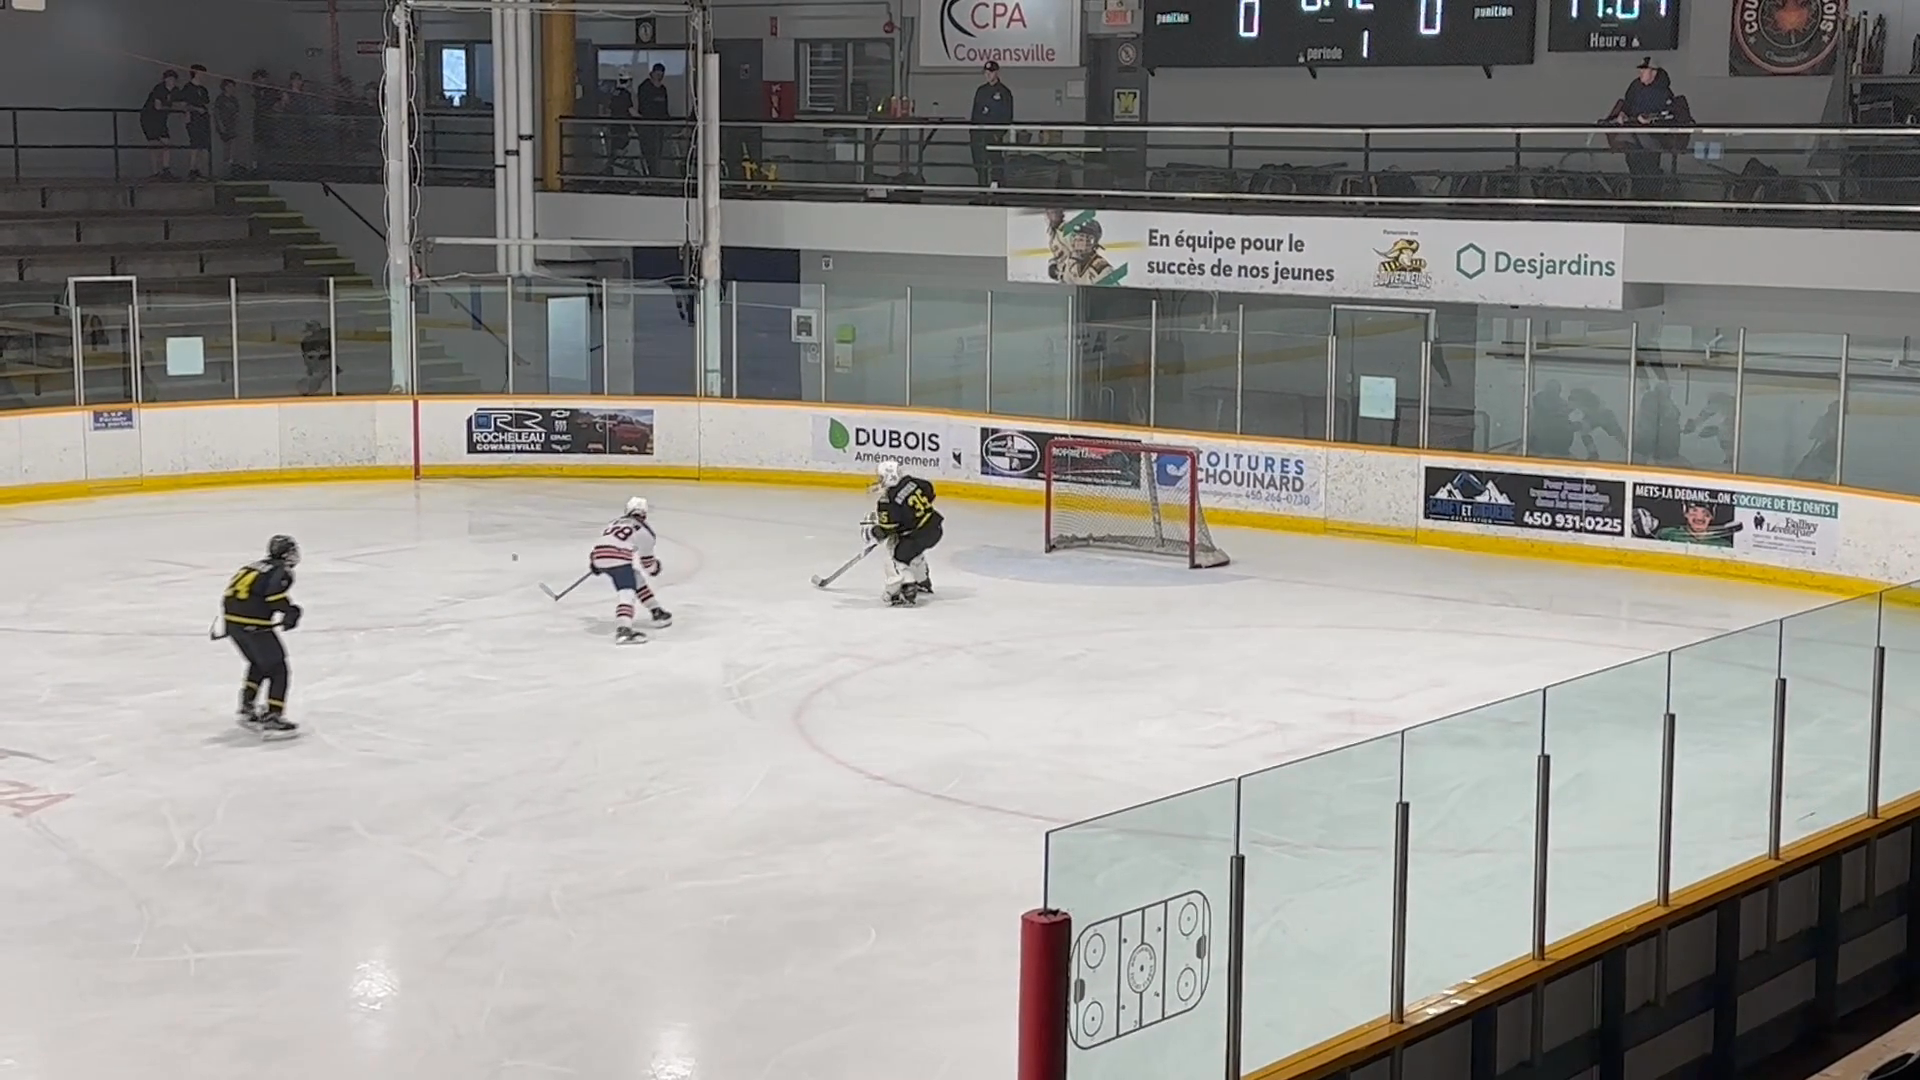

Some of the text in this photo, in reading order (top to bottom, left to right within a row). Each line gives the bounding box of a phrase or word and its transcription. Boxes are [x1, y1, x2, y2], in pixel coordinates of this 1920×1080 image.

[970, 2, 1027, 29] CPA
[1474, 5, 1513, 19] punition
[1590, 32, 1627, 48] Heure
[953, 43, 1056, 62] Cowansville
[1148, 228, 1305, 255] En équipe pour le
[1147, 257, 1335, 284] succès de nos jeunes
[1494, 251, 1615, 279] Desjardins
[473, 432, 545, 443] ROCHELEAU
[855, 427, 940, 451] DUBOIS
[855, 451, 940, 467] Aménagement
[1461, 504, 1473, 517] ET
[1732, 493, 1772, 509] S'OCCUPE
[1774, 498, 1785, 510] DE
[1786, 499, 1801, 513] TES
[1803, 501, 1831, 516] DENTS
[1523, 510, 1622, 532] 450 931-0225
